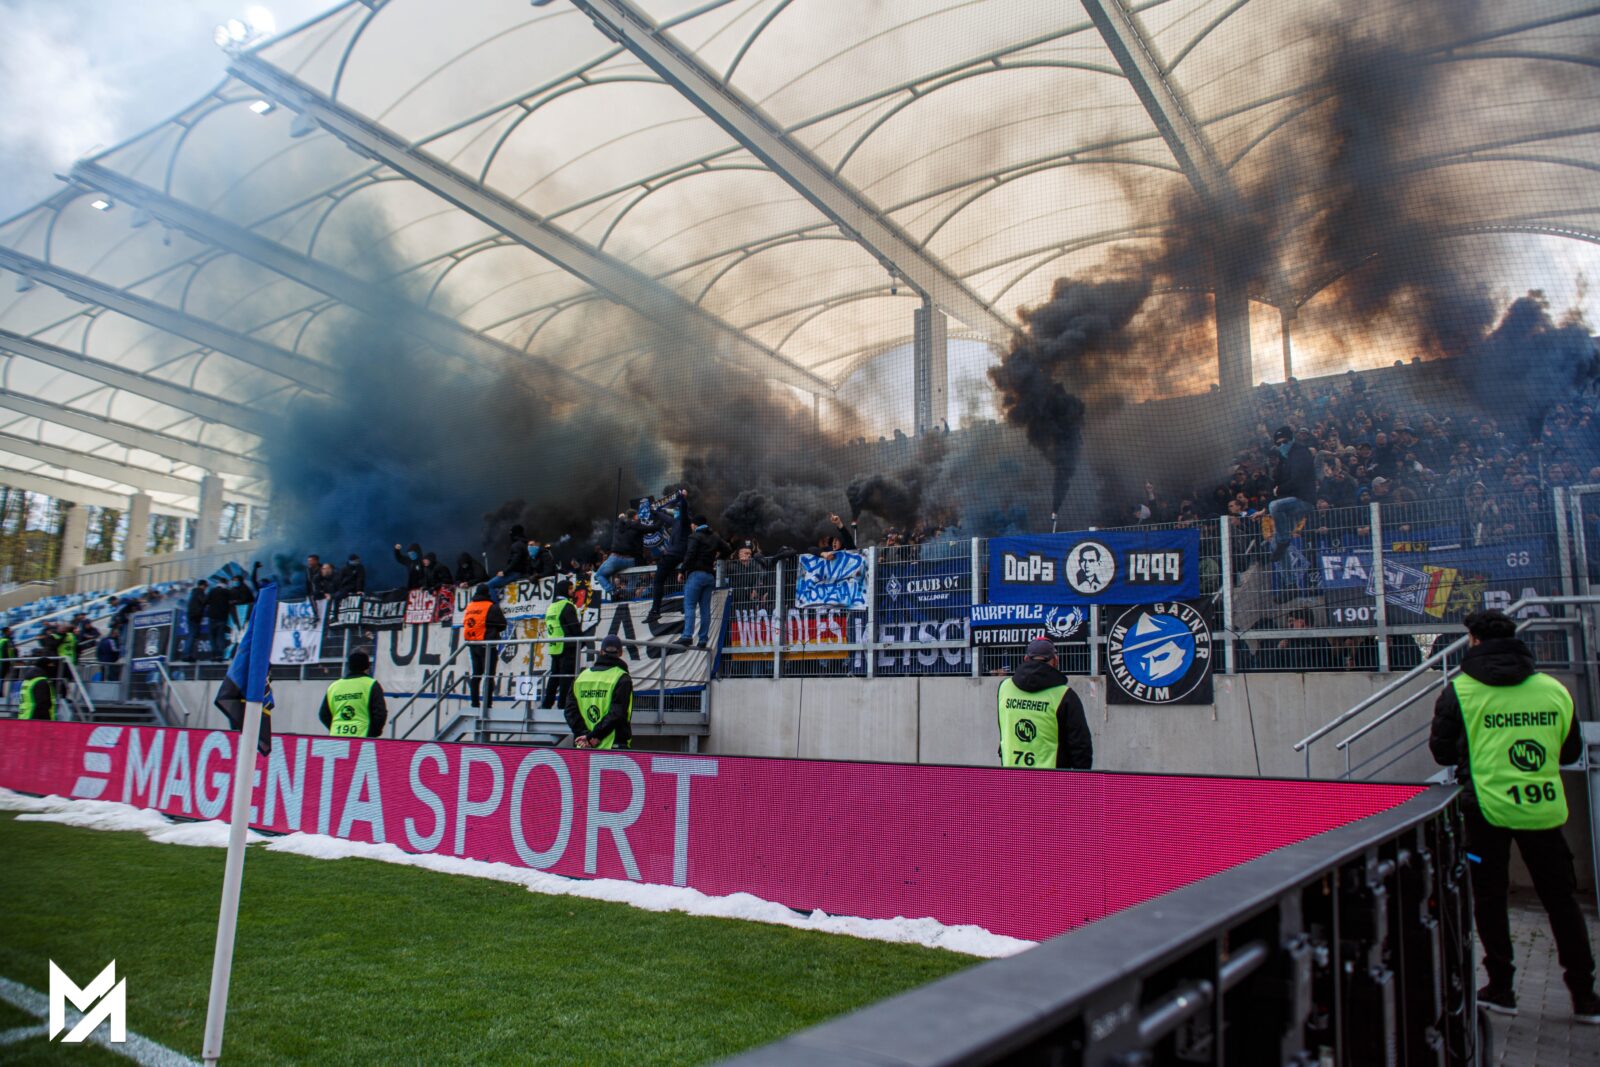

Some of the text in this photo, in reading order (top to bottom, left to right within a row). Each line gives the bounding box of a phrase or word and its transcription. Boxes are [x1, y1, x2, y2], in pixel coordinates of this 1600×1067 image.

[1004, 552, 1180, 582] DoPa 1999
[906, 579, 941, 593] CLUB
[972, 604, 1043, 621] KURPFALZ
[1153, 602, 1209, 660] GAUNER
[1110, 624, 1170, 701] MANNHEIM
[519, 680, 534, 696] C2
[1006, 698, 1050, 713] SICHERHEIT
[1484, 711, 1559, 729] SICHERHEIT
[336, 725, 358, 735] 190
[1013, 750, 1036, 767] 76
[1506, 781, 1557, 805] 196
[403, 742, 719, 888] SPORT
